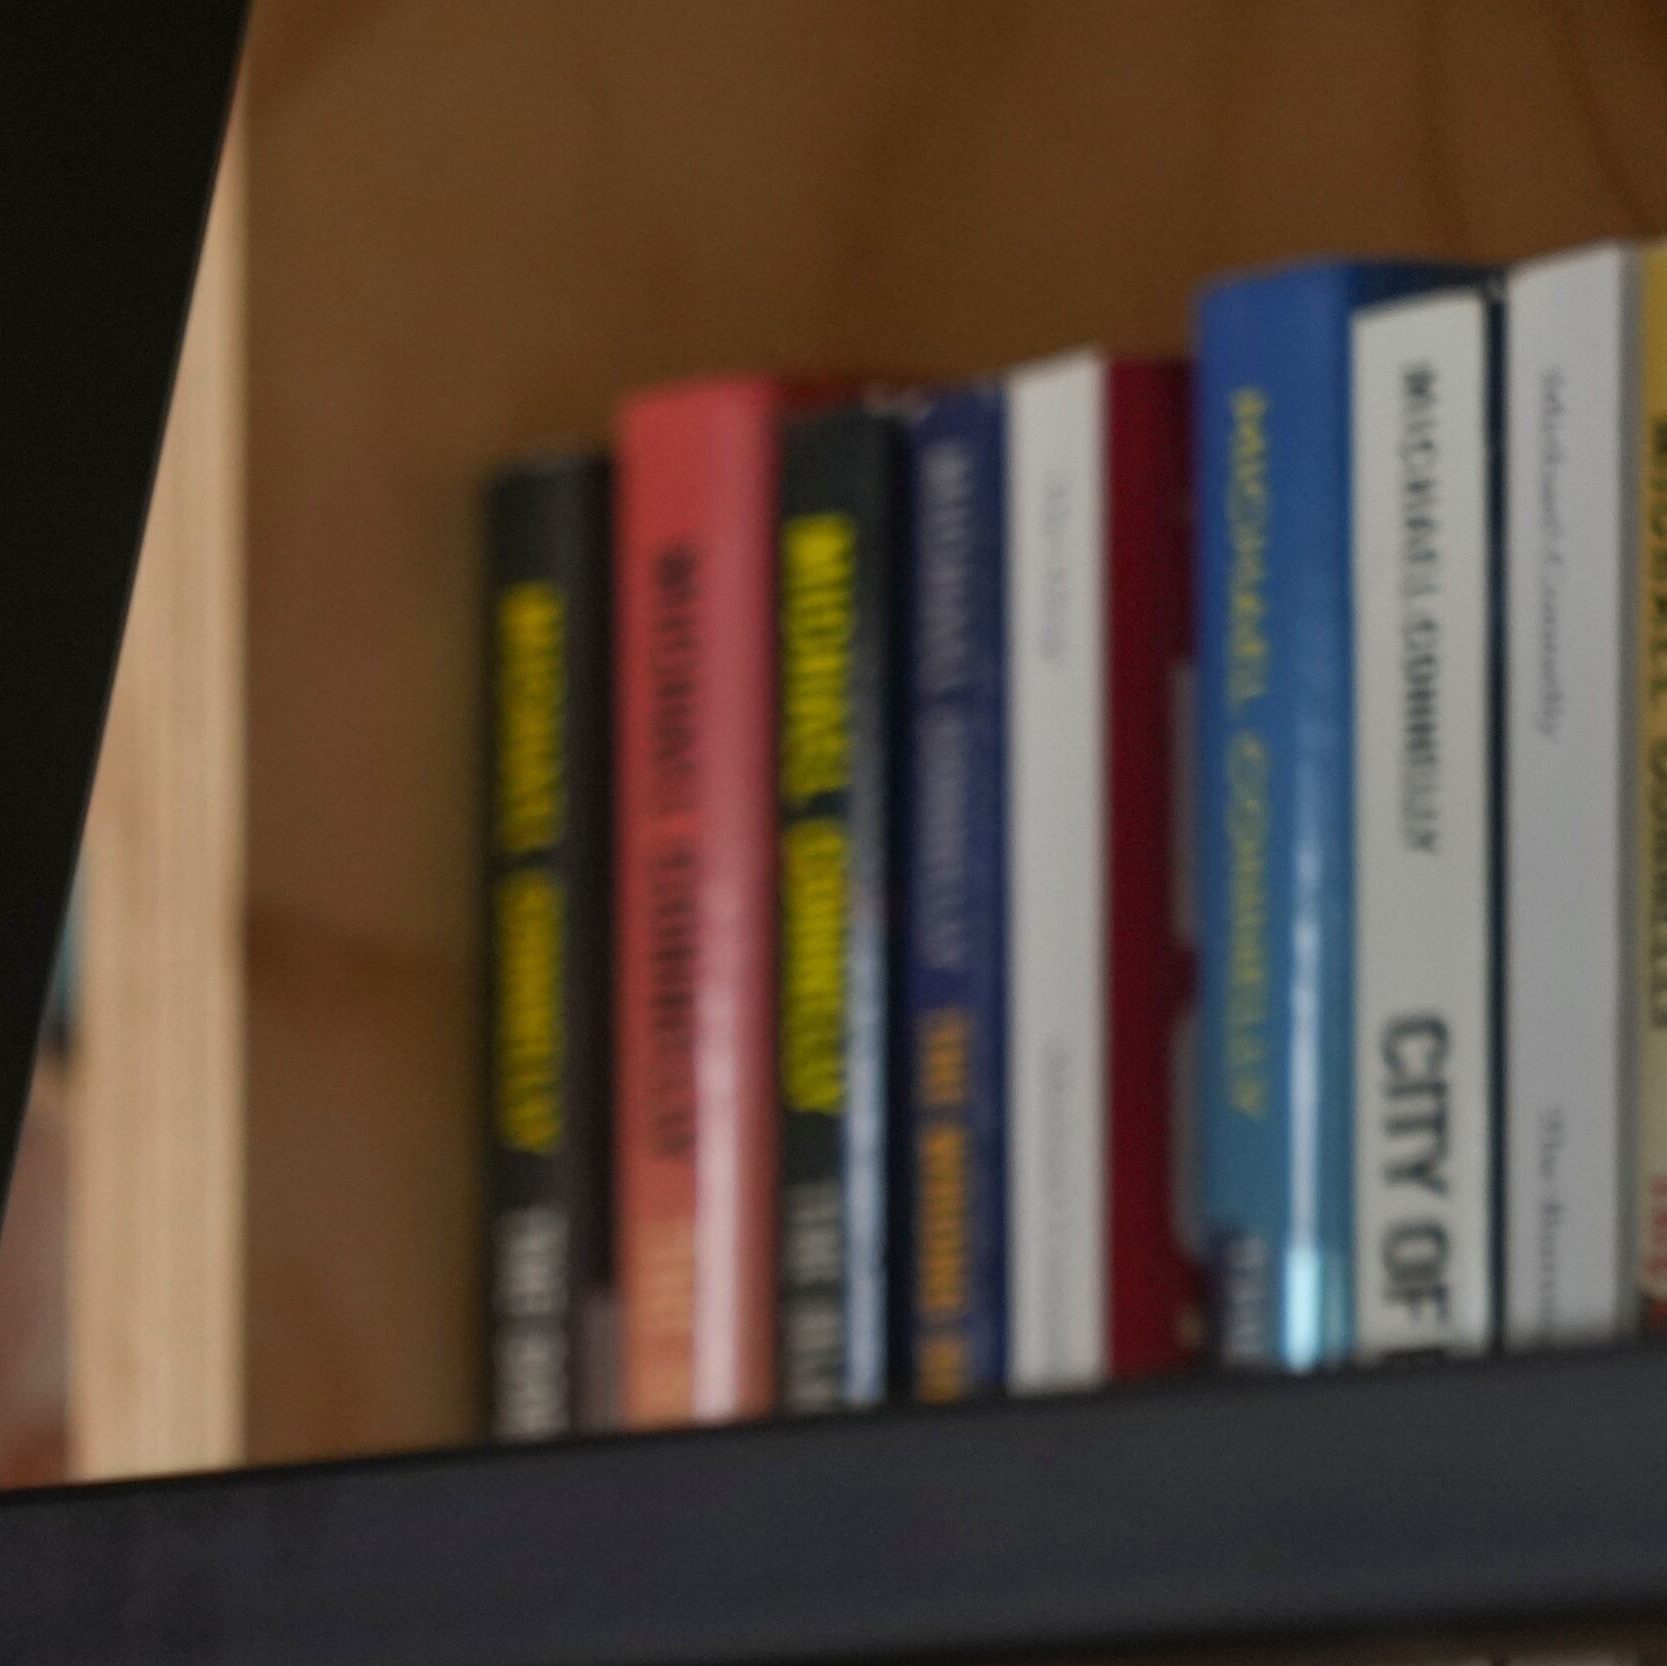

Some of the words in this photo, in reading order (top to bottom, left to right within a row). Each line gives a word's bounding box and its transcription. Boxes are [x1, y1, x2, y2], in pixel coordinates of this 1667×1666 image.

[1229, 389, 1270, 702] MICHAEL
[1399, 361, 1439, 600] MICHAEL
[1399, 608, 1439, 857] CONNELLY
[782, 815, 857, 1118] CONNELLY
[1227, 731, 1265, 1119] CONNELLY
[1378, 1012, 1450, 1199] CITY
[1378, 1217, 1450, 1324] OF
